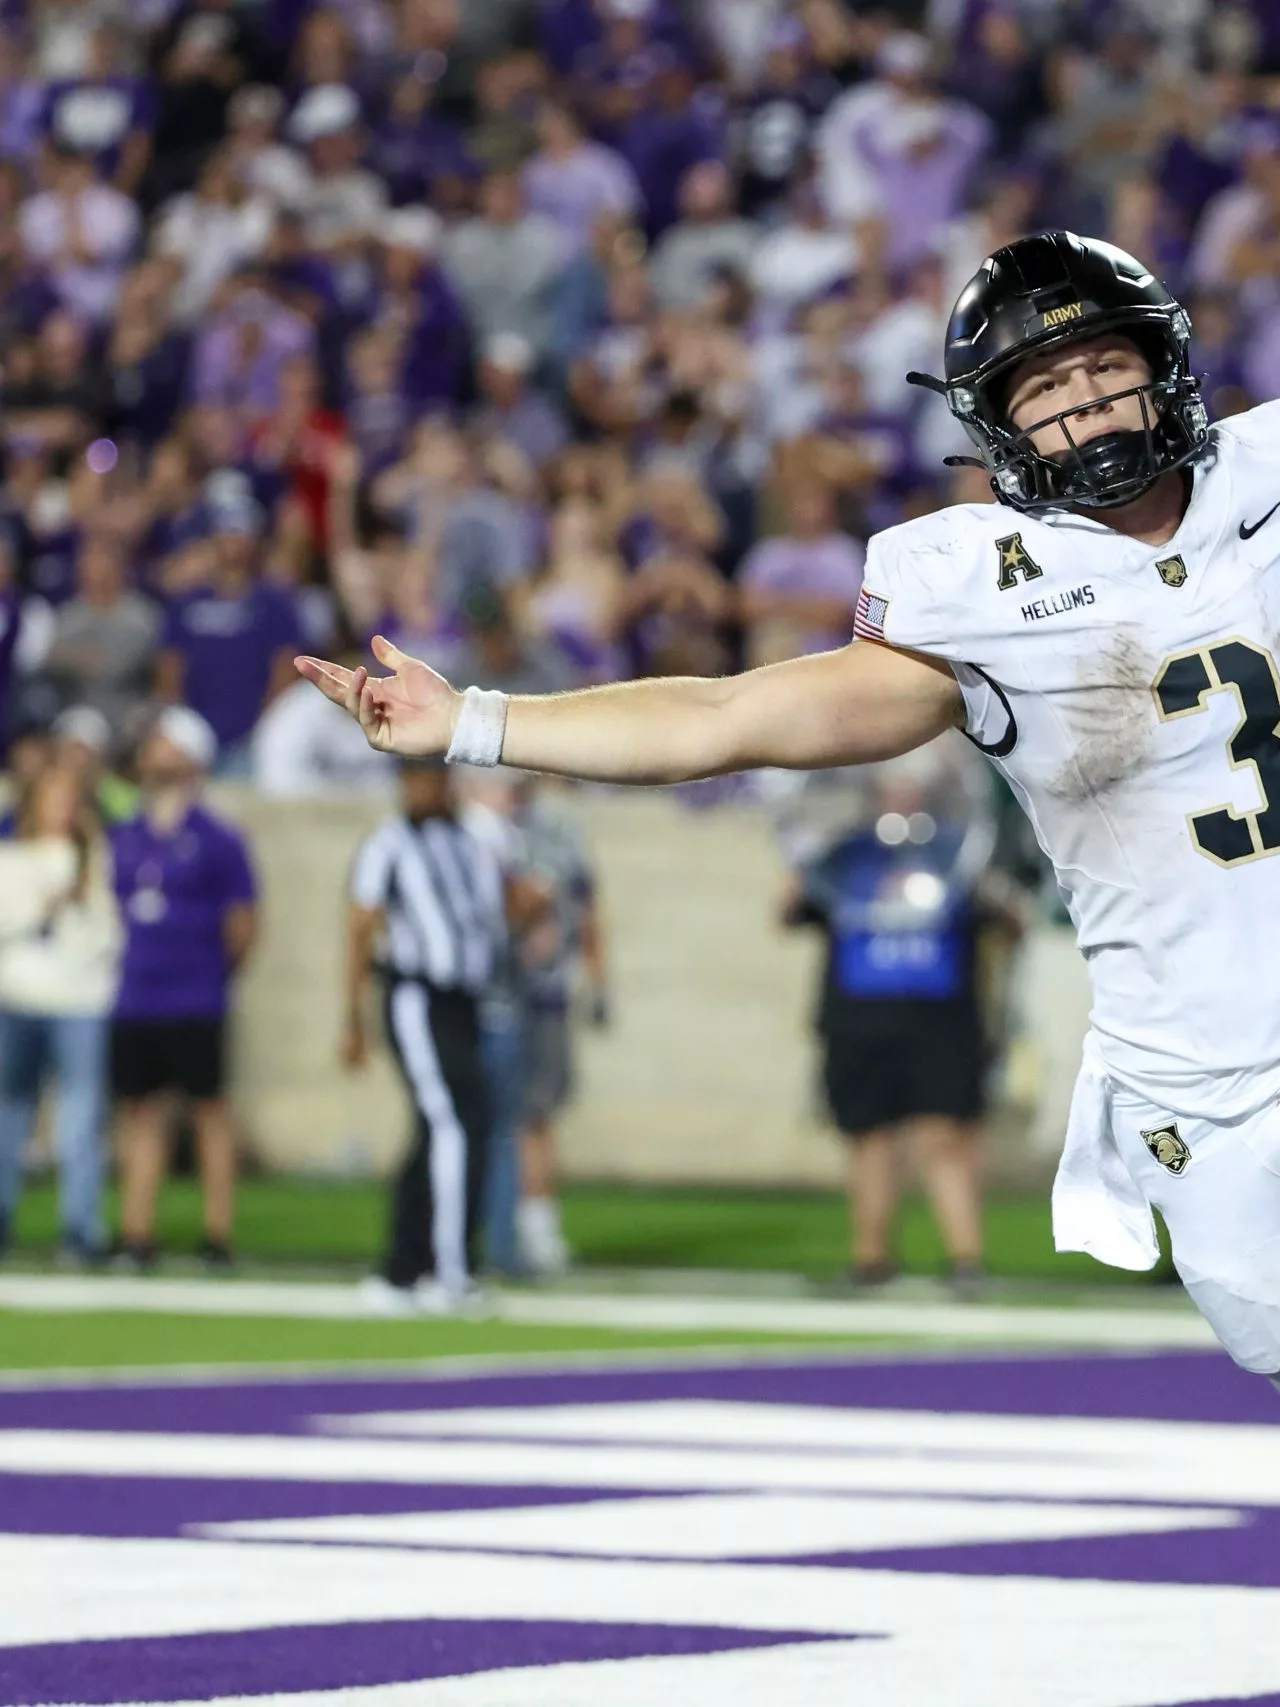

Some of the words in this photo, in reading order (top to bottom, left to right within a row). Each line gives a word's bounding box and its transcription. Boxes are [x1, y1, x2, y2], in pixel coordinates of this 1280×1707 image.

[1043, 302, 1083, 328] ARMY
[995, 532, 1044, 591] A
[1021, 584, 1096, 622] HELLUMS
